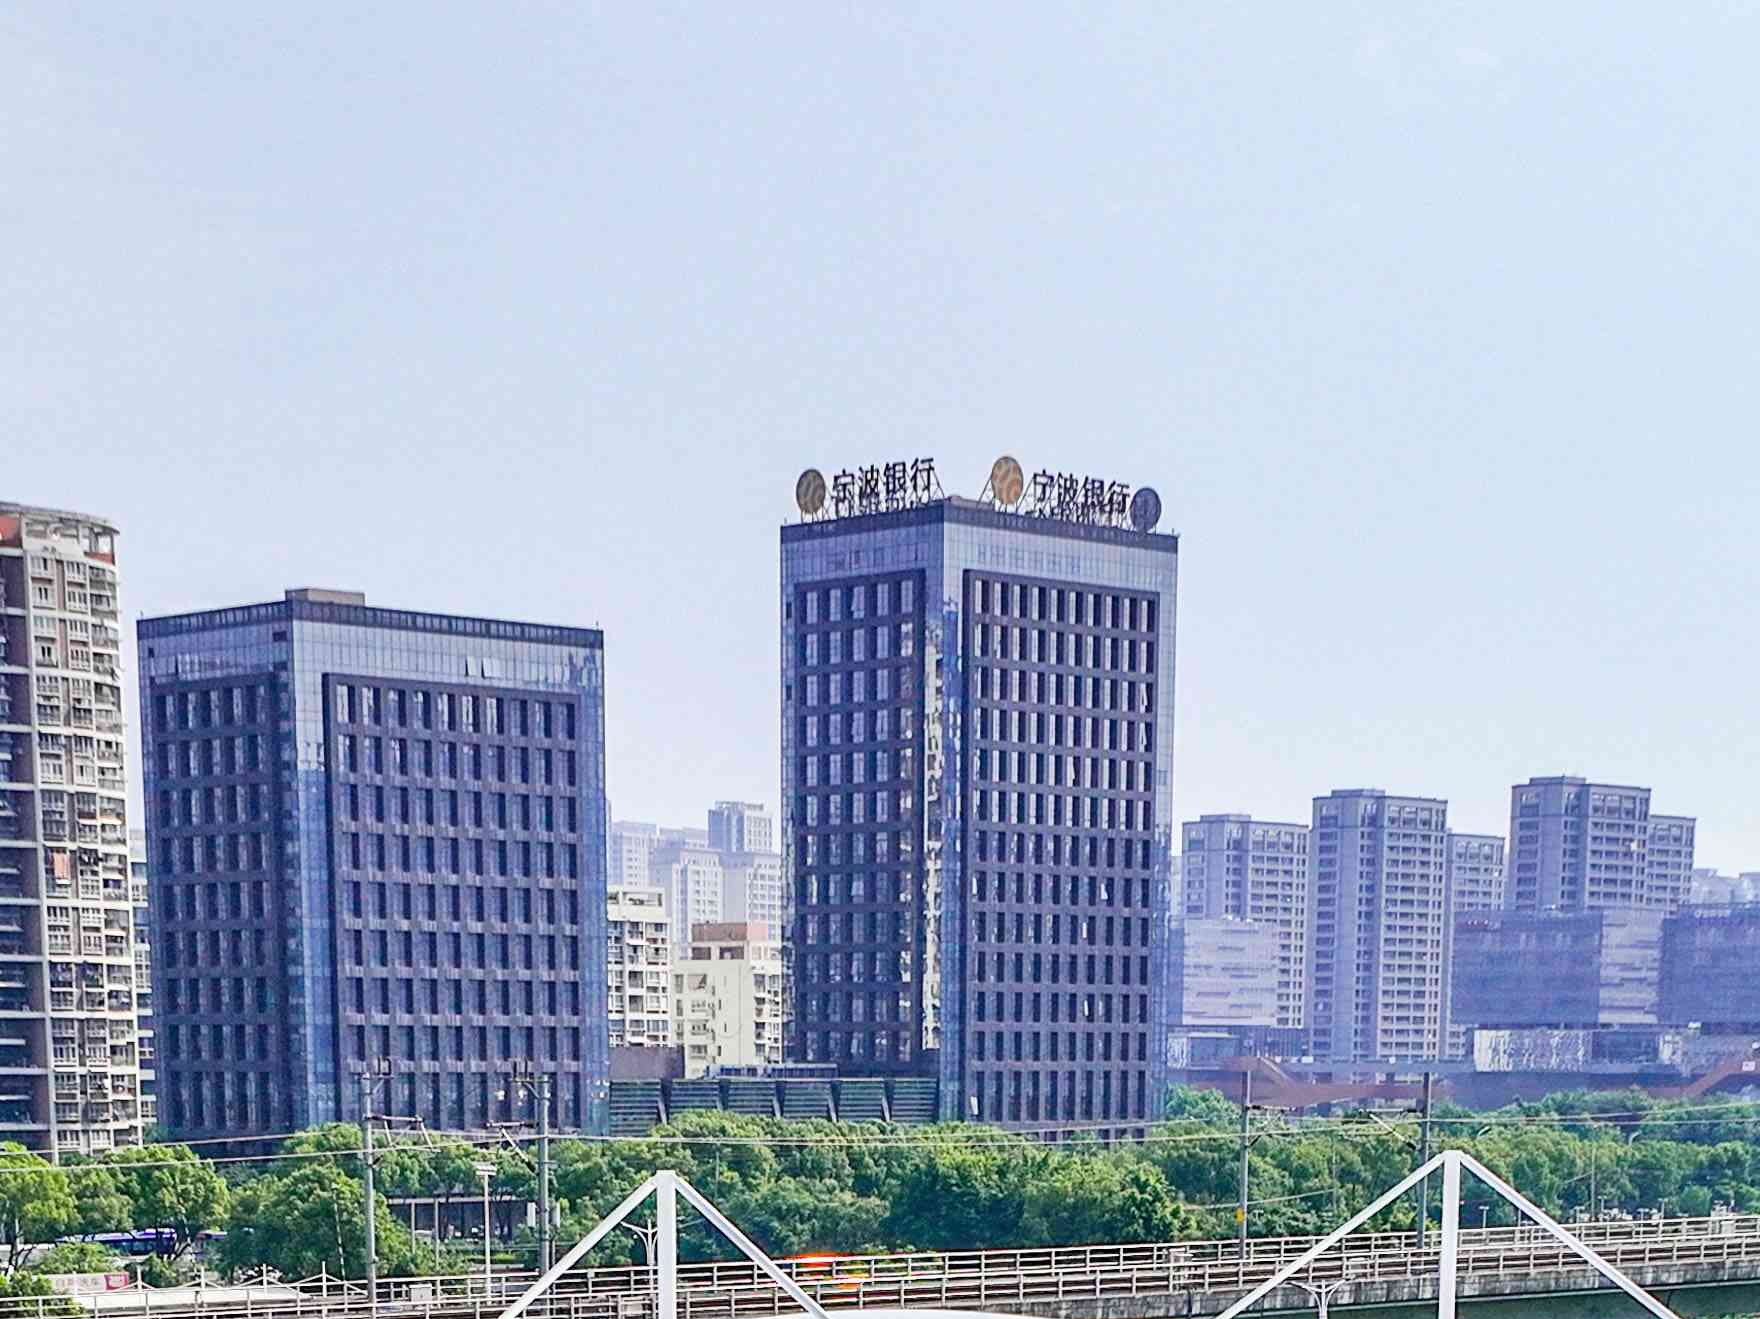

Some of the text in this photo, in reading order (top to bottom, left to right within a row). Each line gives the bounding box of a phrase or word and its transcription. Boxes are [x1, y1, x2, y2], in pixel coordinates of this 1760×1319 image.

[832, 457, 935, 504] 宁波银行
[1033, 469, 1130, 514] 宁波银行
